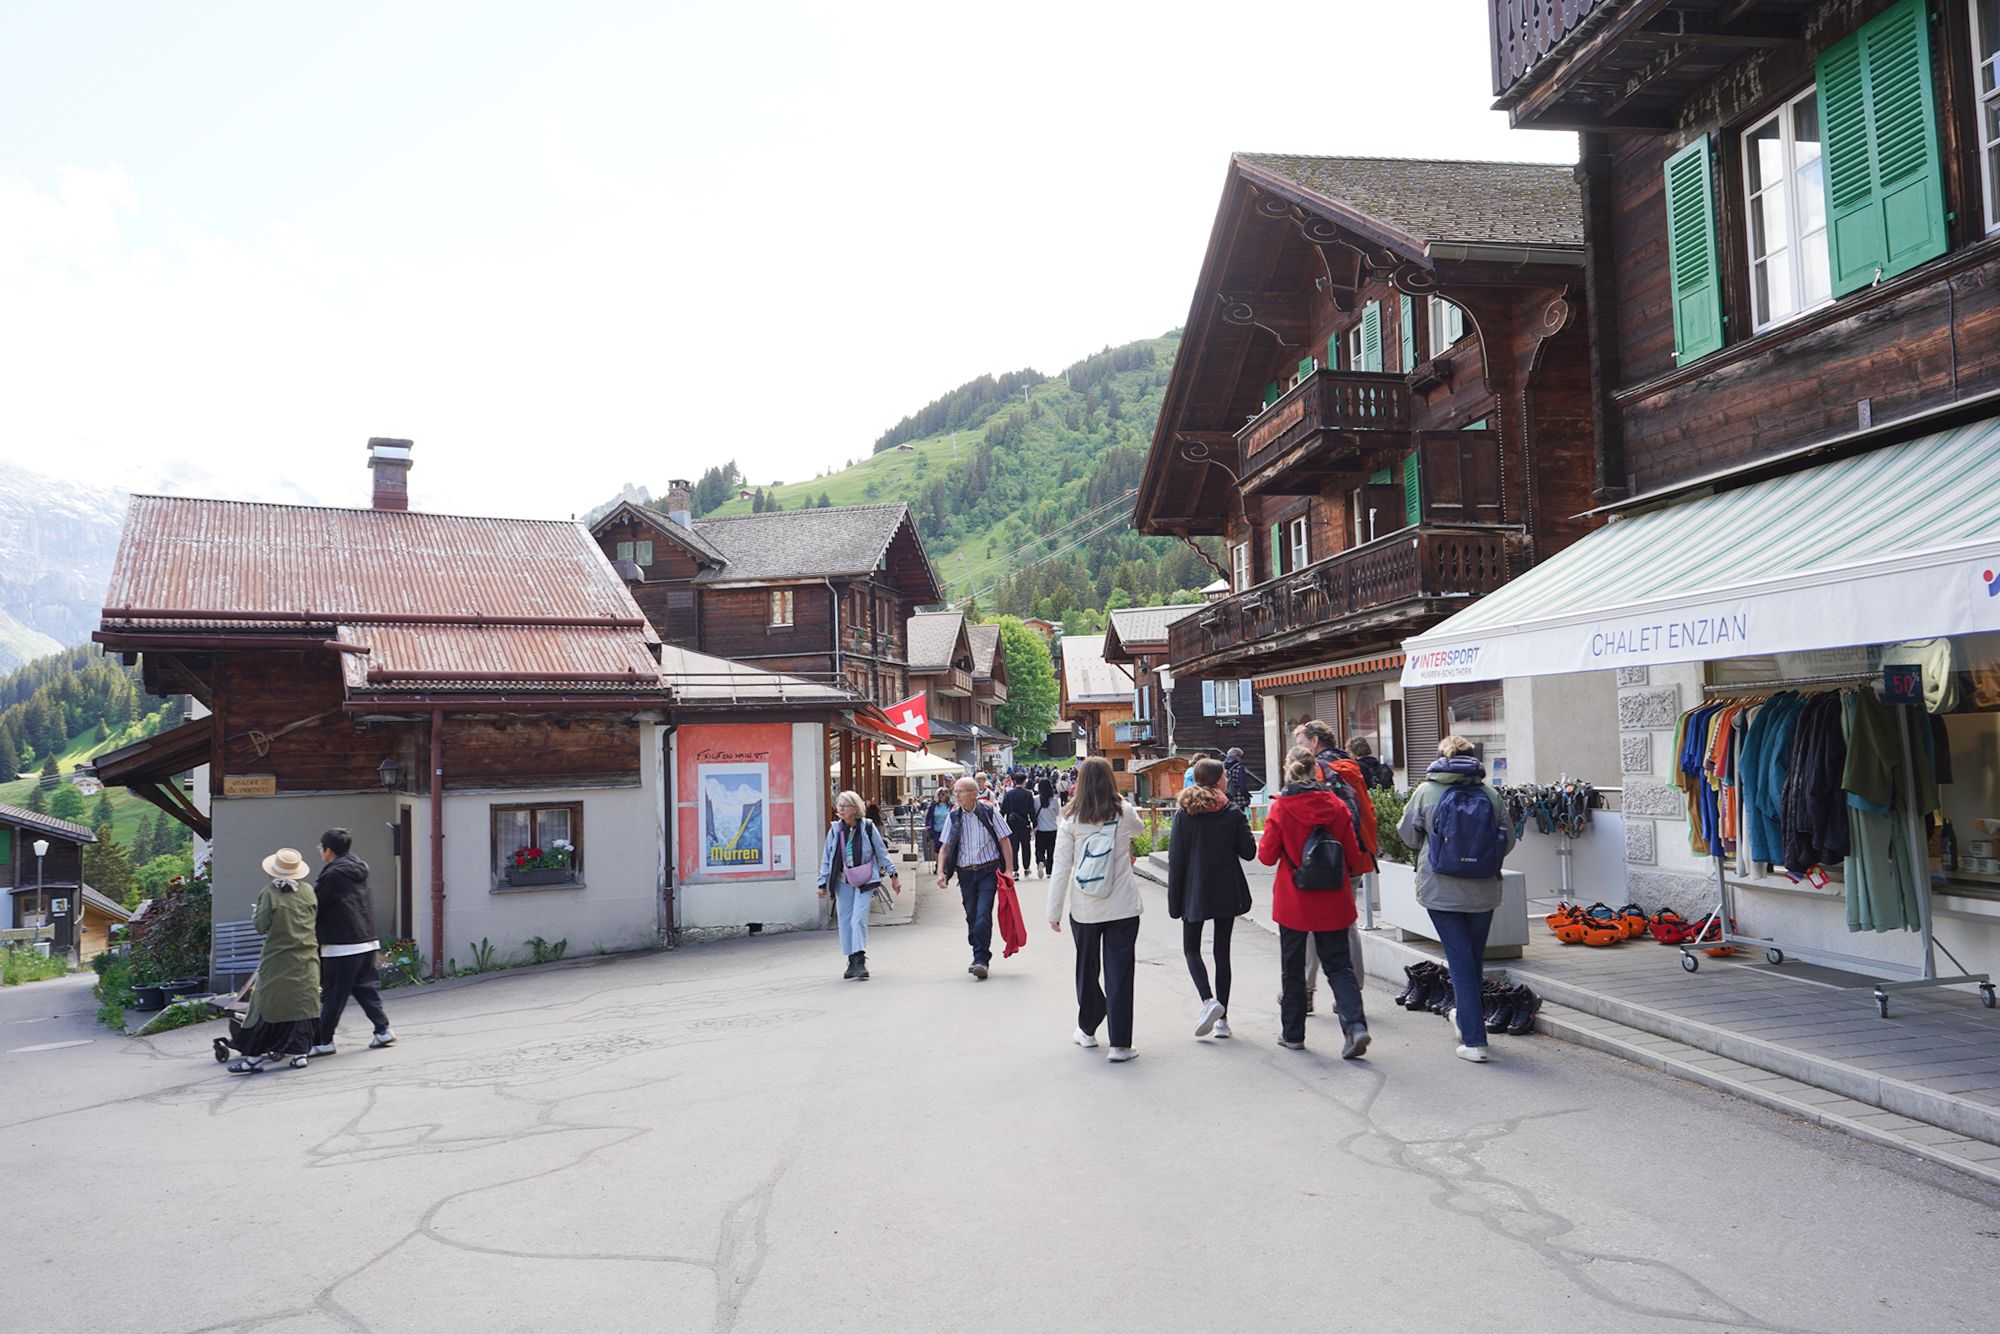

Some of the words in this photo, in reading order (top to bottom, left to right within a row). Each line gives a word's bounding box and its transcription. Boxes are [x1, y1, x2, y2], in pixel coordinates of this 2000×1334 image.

[1592, 625, 1663, 656] CHALET
[1669, 613, 1747, 649] ENZIAN
[1419, 646, 1480, 669] INTERSPORT
